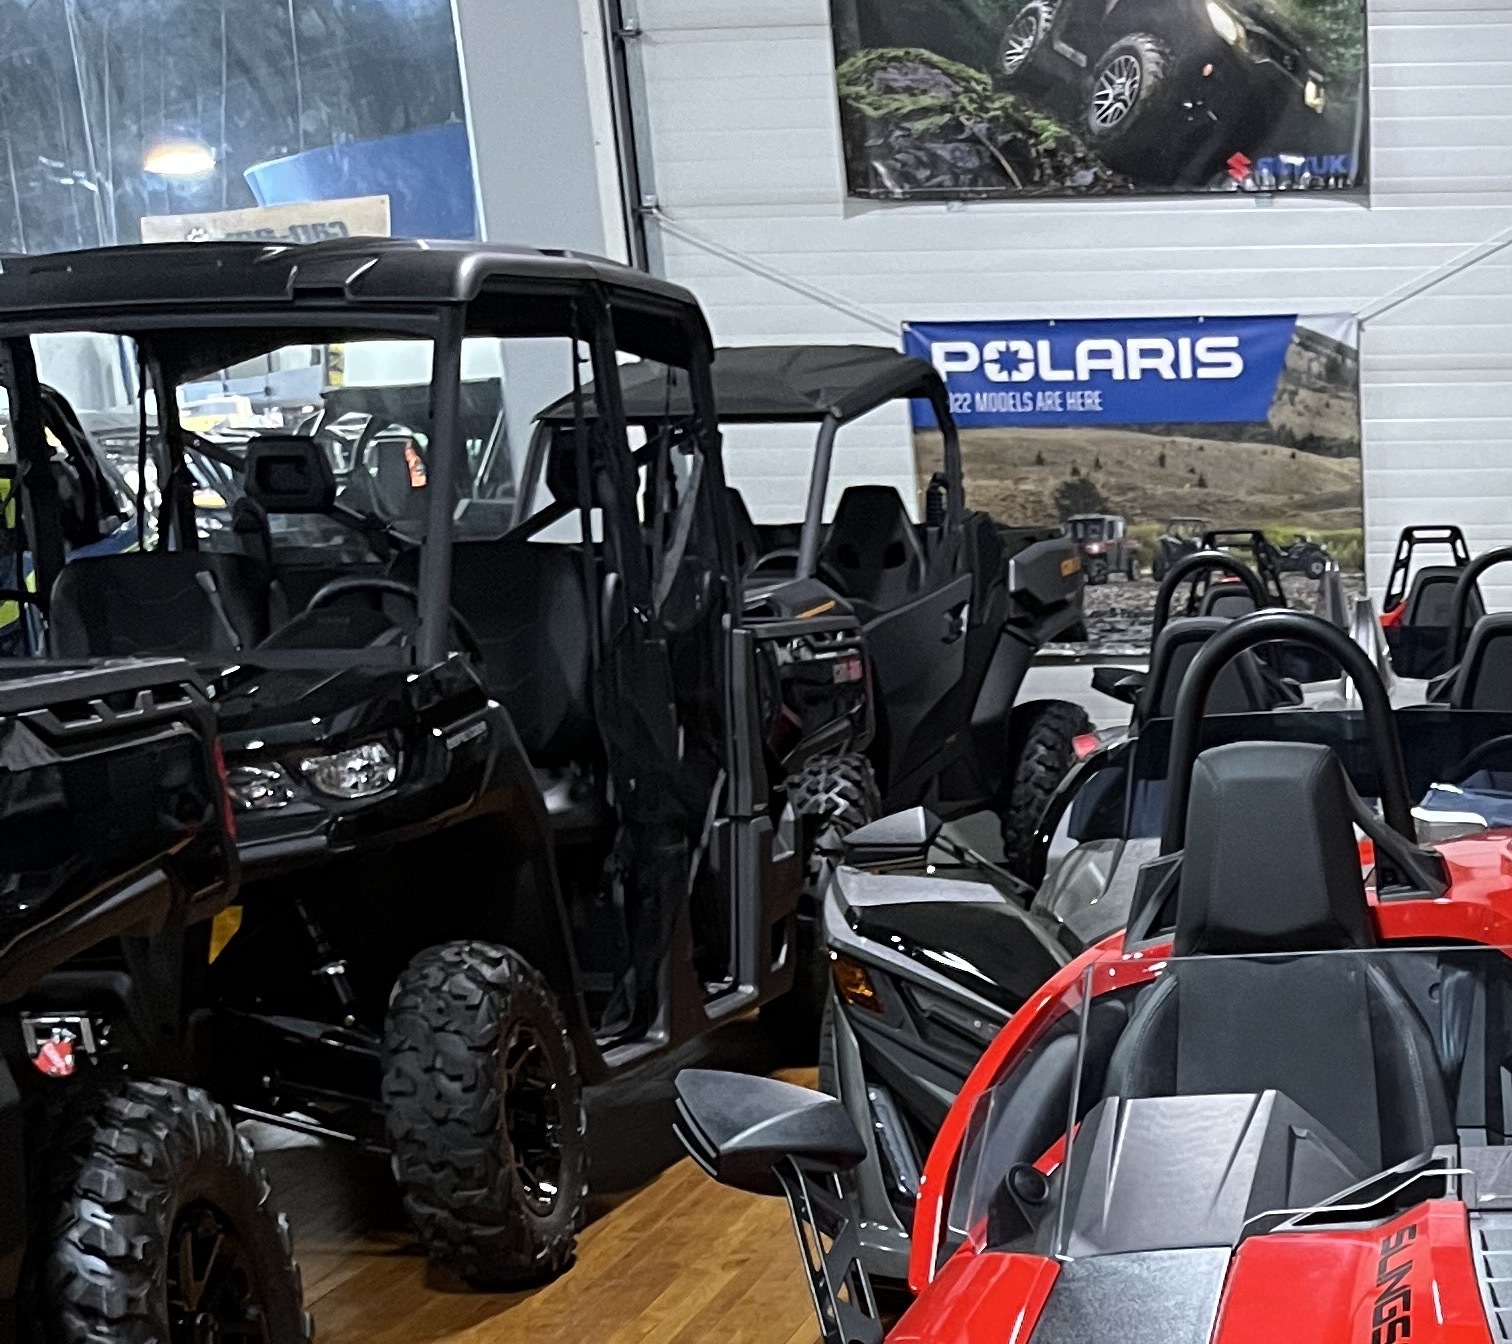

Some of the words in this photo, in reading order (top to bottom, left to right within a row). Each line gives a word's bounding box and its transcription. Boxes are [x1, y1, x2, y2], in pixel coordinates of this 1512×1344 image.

[931, 335, 1244, 382] POLARIS
[975, 391, 1033, 413] MODELS
[1035, 391, 1064, 412] ARE
[1065, 390, 1104, 412] HERE
